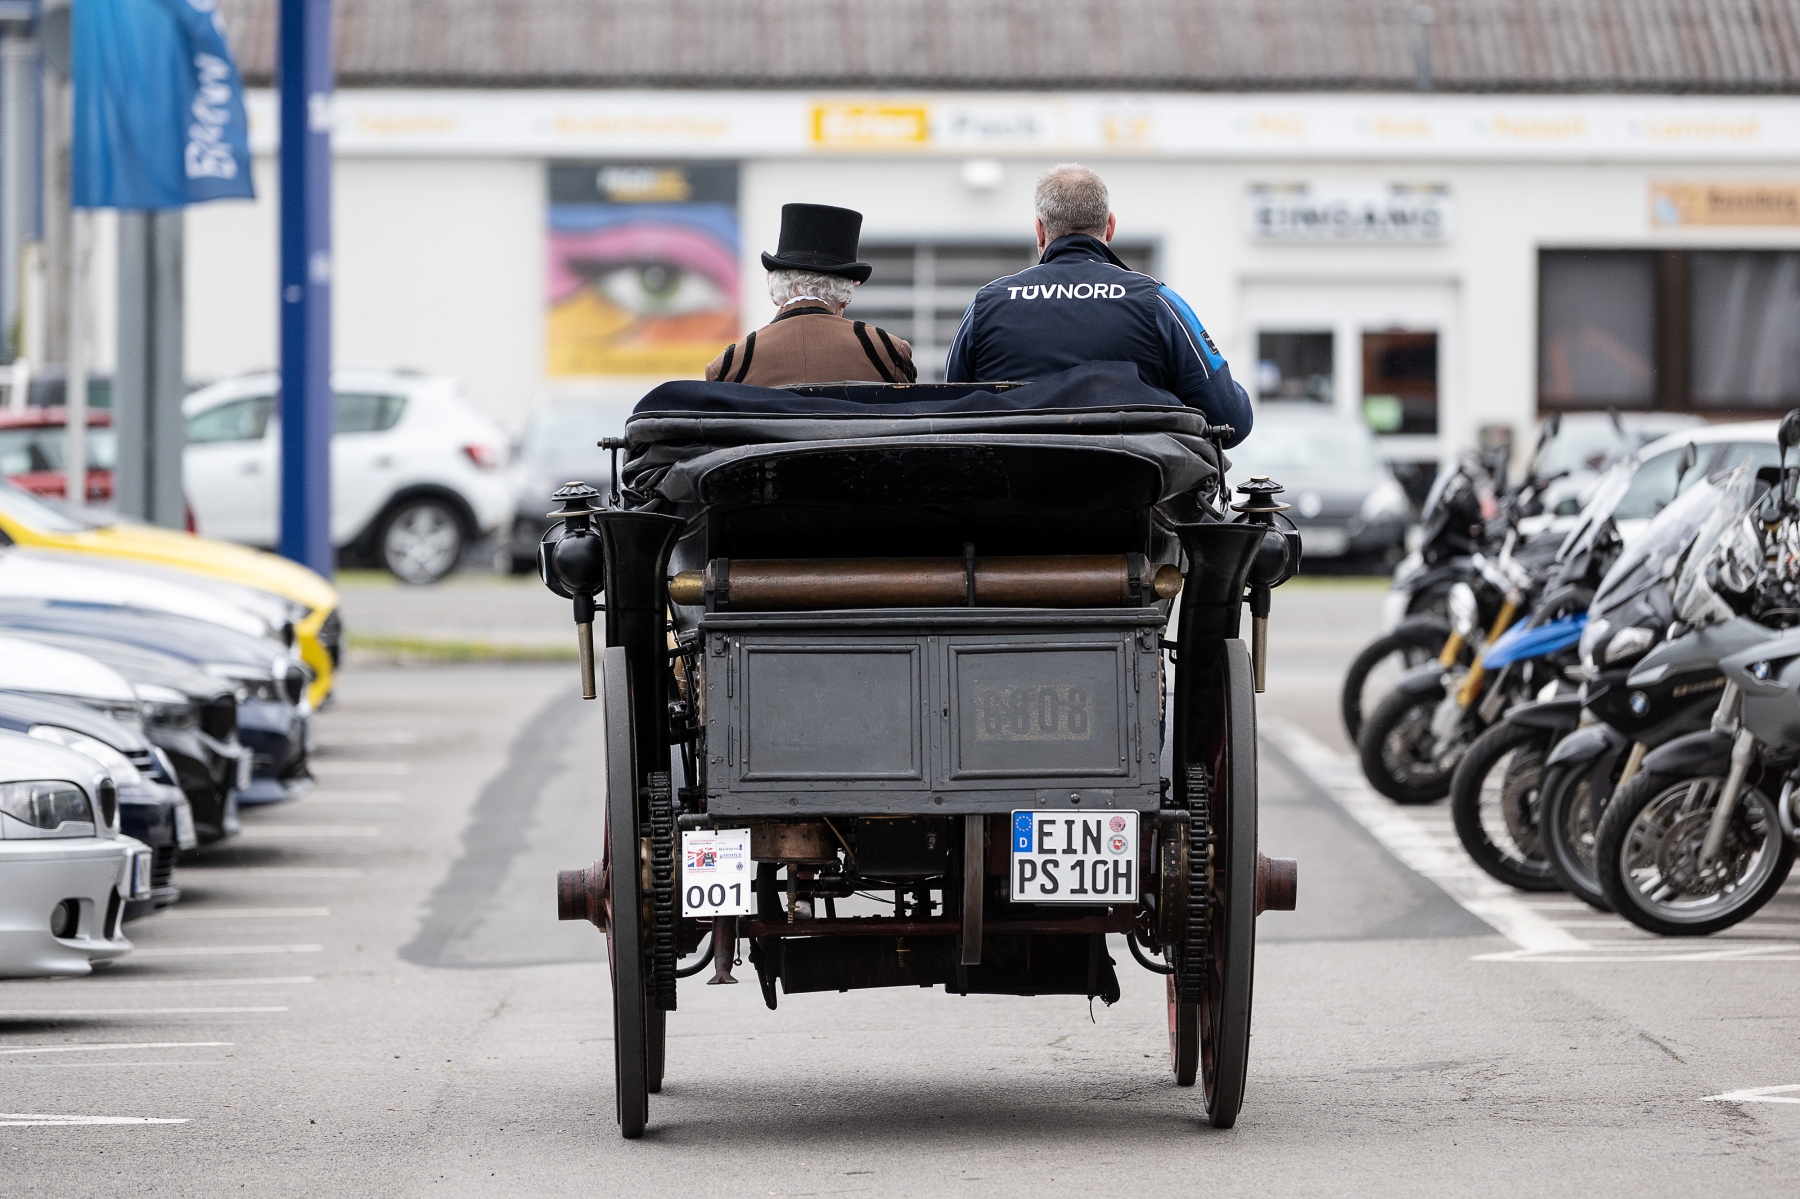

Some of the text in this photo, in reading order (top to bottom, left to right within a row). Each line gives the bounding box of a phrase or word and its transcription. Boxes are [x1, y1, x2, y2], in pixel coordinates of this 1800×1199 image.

[1019, 837, 1028, 848] D
[1037, 819, 1102, 855] EIN
[1018, 858, 1132, 895] PS 10H
[686, 883, 741, 909] 001
